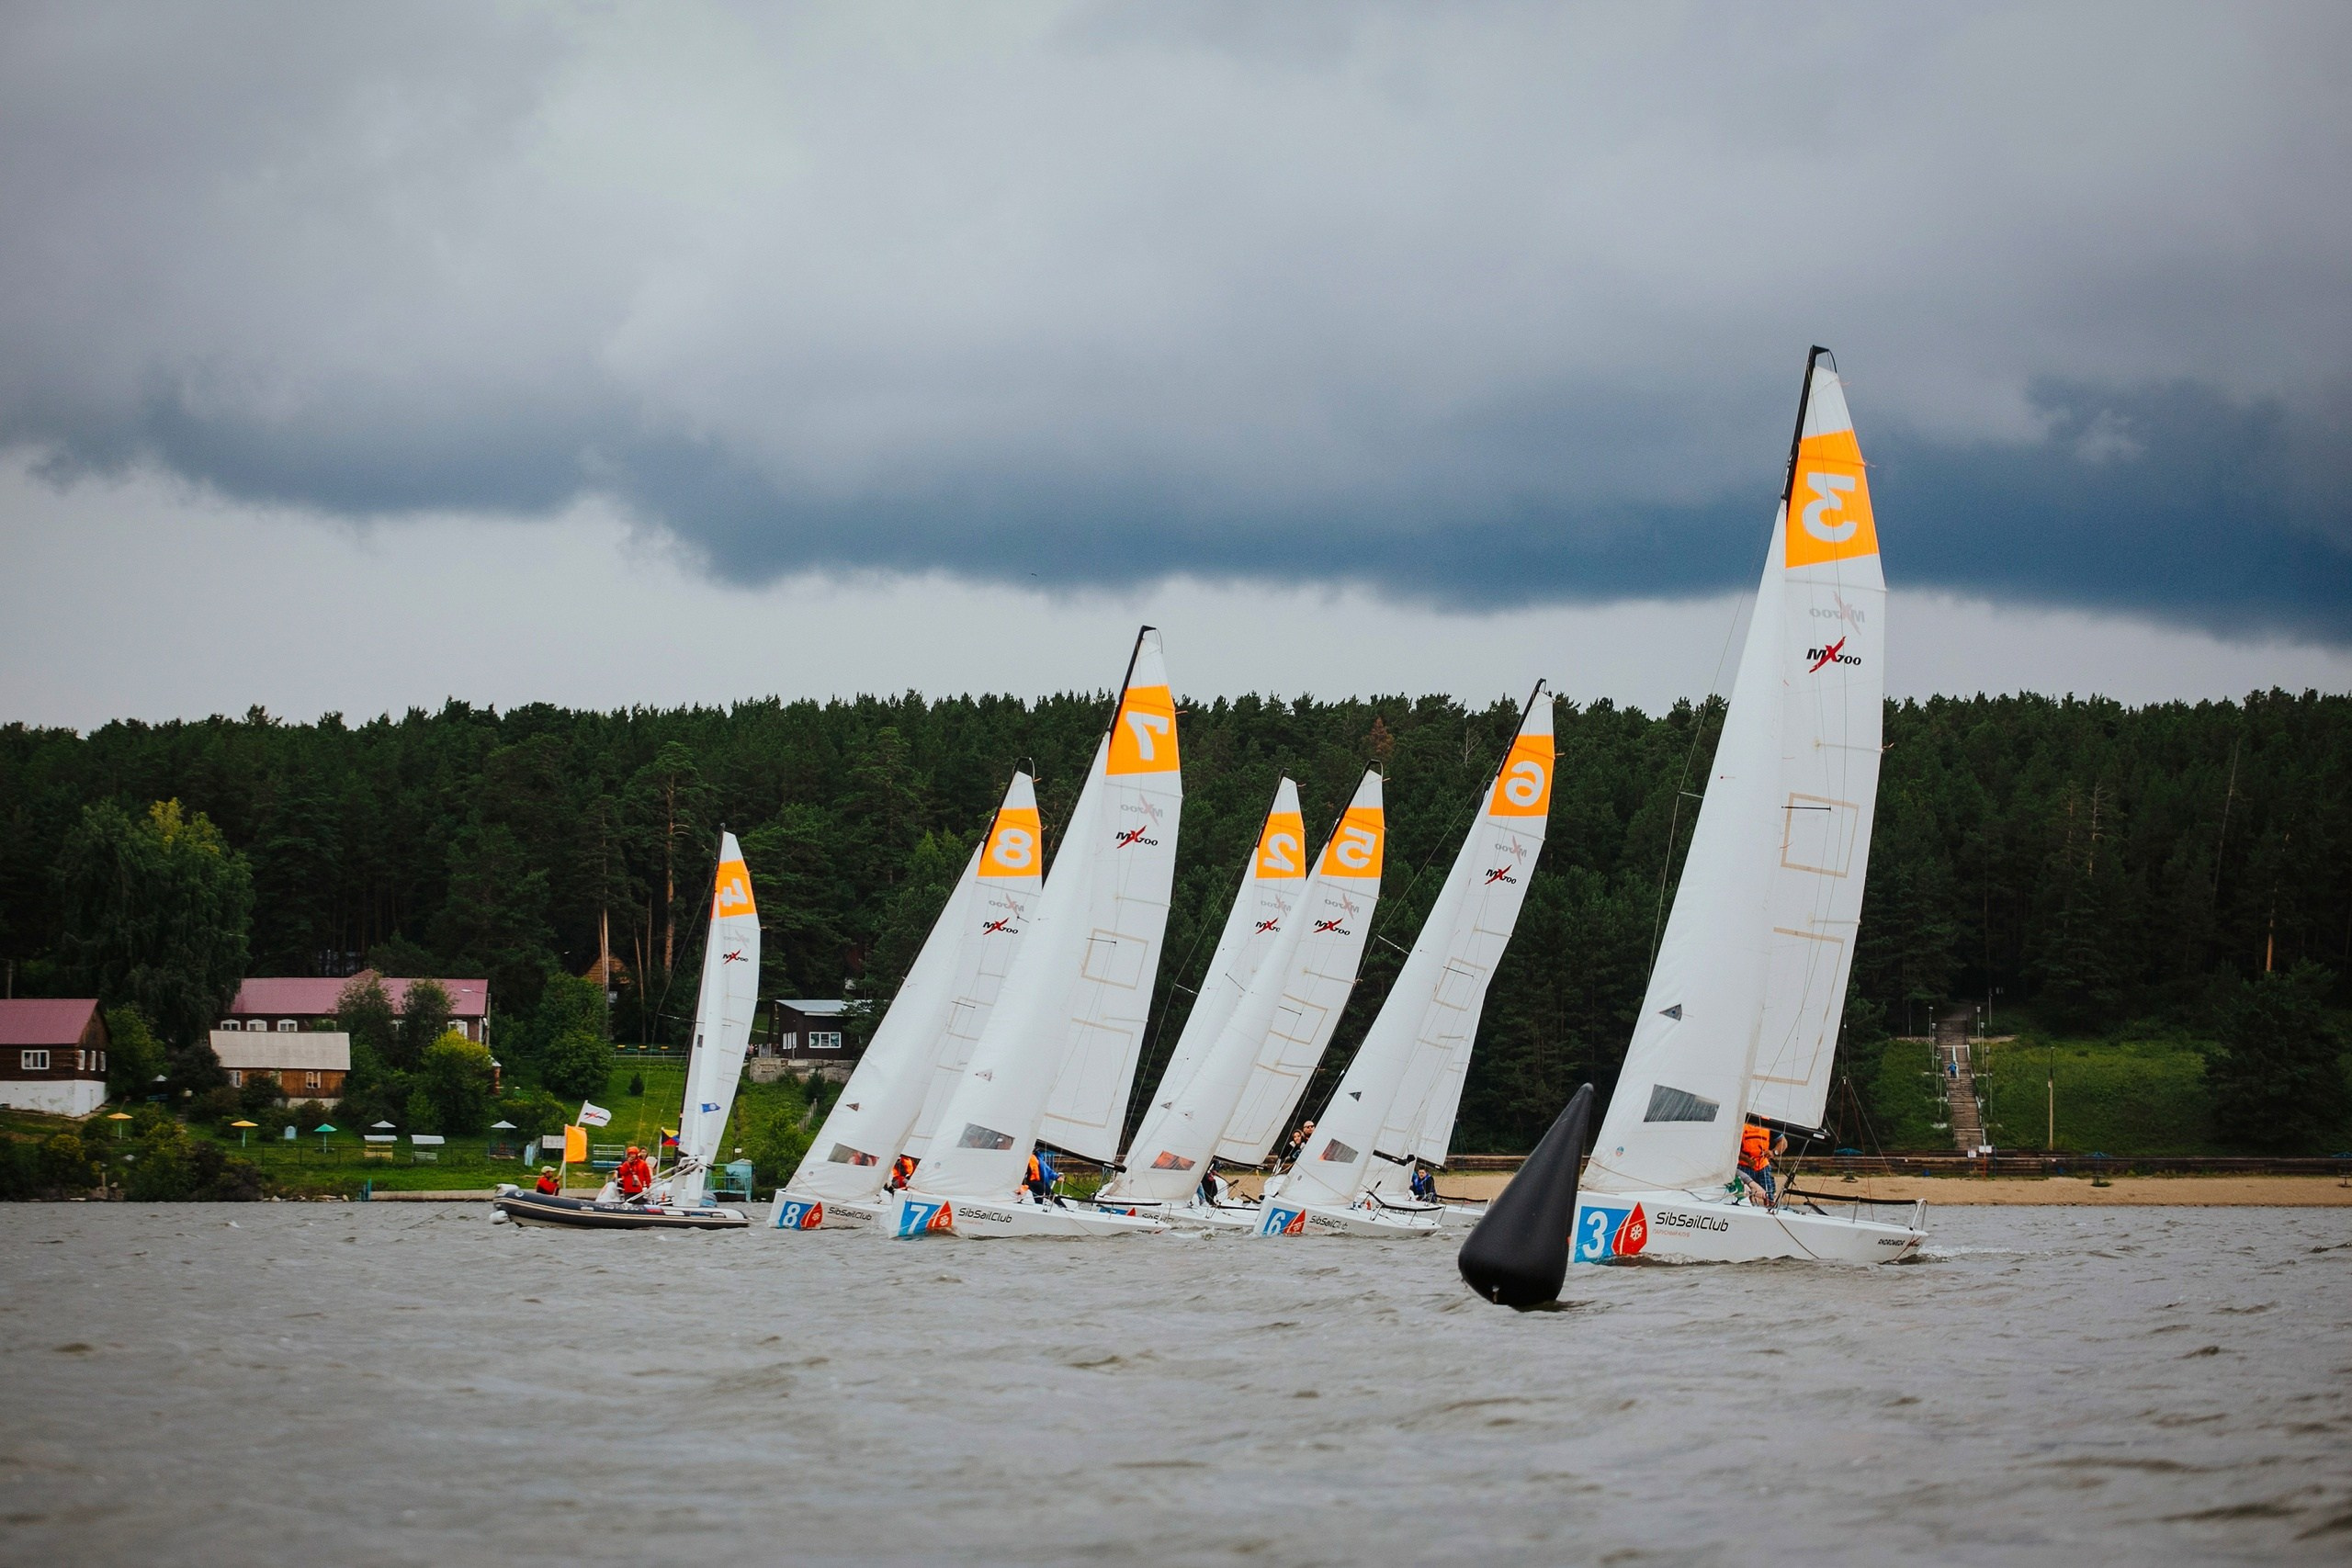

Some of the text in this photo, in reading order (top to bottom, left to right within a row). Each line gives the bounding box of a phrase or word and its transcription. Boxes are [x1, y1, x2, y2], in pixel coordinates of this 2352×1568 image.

[1805, 636, 1862, 673] MX700
[1114, 825, 1159, 850] MX700
[1484, 864, 1517, 886] MX700
[982, 918, 1019, 936] MX700
[1313, 917, 1351, 936] MX700
[782, 1203, 801, 1227] 8
[827, 1206, 873, 1221] SibSailClub
[907, 1205, 929, 1233] 7
[957, 1207, 1012, 1223] SibSailClub
[1268, 1211, 1286, 1236] 6
[1655, 1212, 1729, 1232] SibSailClub
[1582, 1210, 1609, 1257] 3
